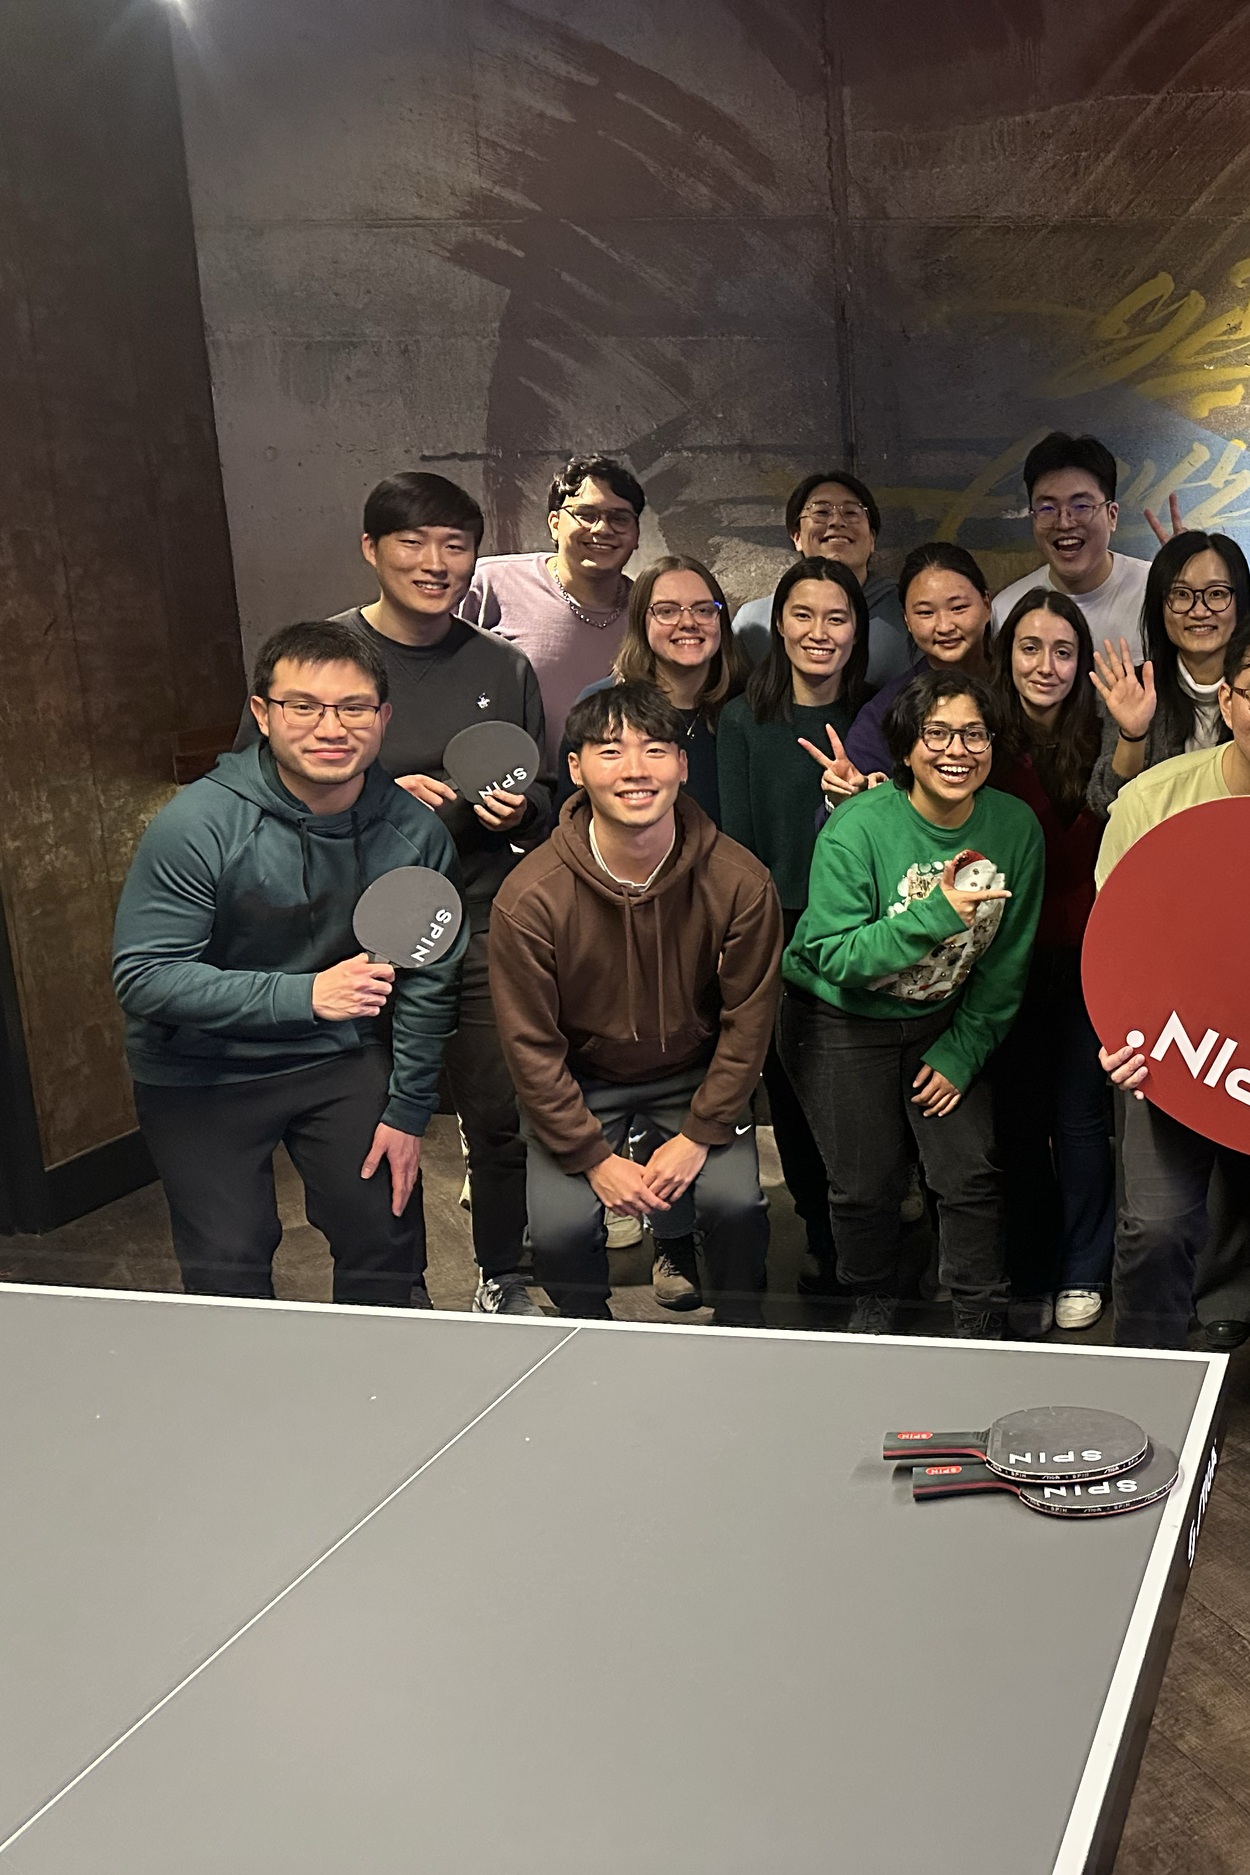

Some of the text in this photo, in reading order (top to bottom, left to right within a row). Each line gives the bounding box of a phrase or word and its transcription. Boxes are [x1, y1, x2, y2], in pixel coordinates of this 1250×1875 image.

[411, 909, 452, 962] SPIN
[1009, 1450, 1102, 1465] SPIN
[931, 1467, 957, 1475] SPIN
[1044, 1480, 1138, 1498] SPIN
